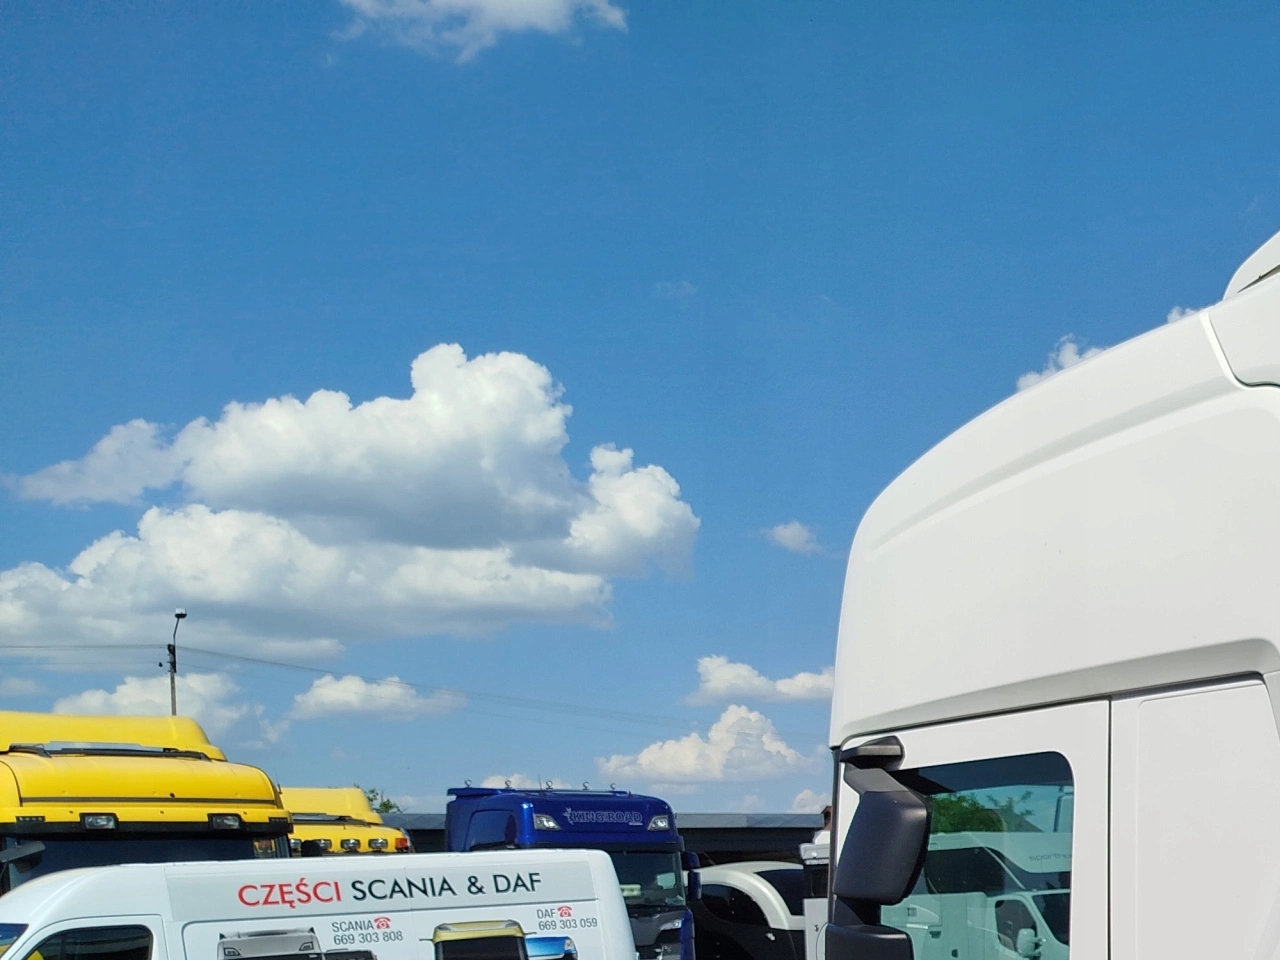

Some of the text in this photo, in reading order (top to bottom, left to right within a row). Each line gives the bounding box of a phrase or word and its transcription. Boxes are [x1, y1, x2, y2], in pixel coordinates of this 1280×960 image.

[237, 872, 542, 909] CZĘŚCI SCANIA & DAF
[536, 908, 556, 919] DAF
[331, 919, 375, 932] SCANIA
[538, 917, 598, 931] 669 303 059
[333, 930, 403, 945] 669 303 808
